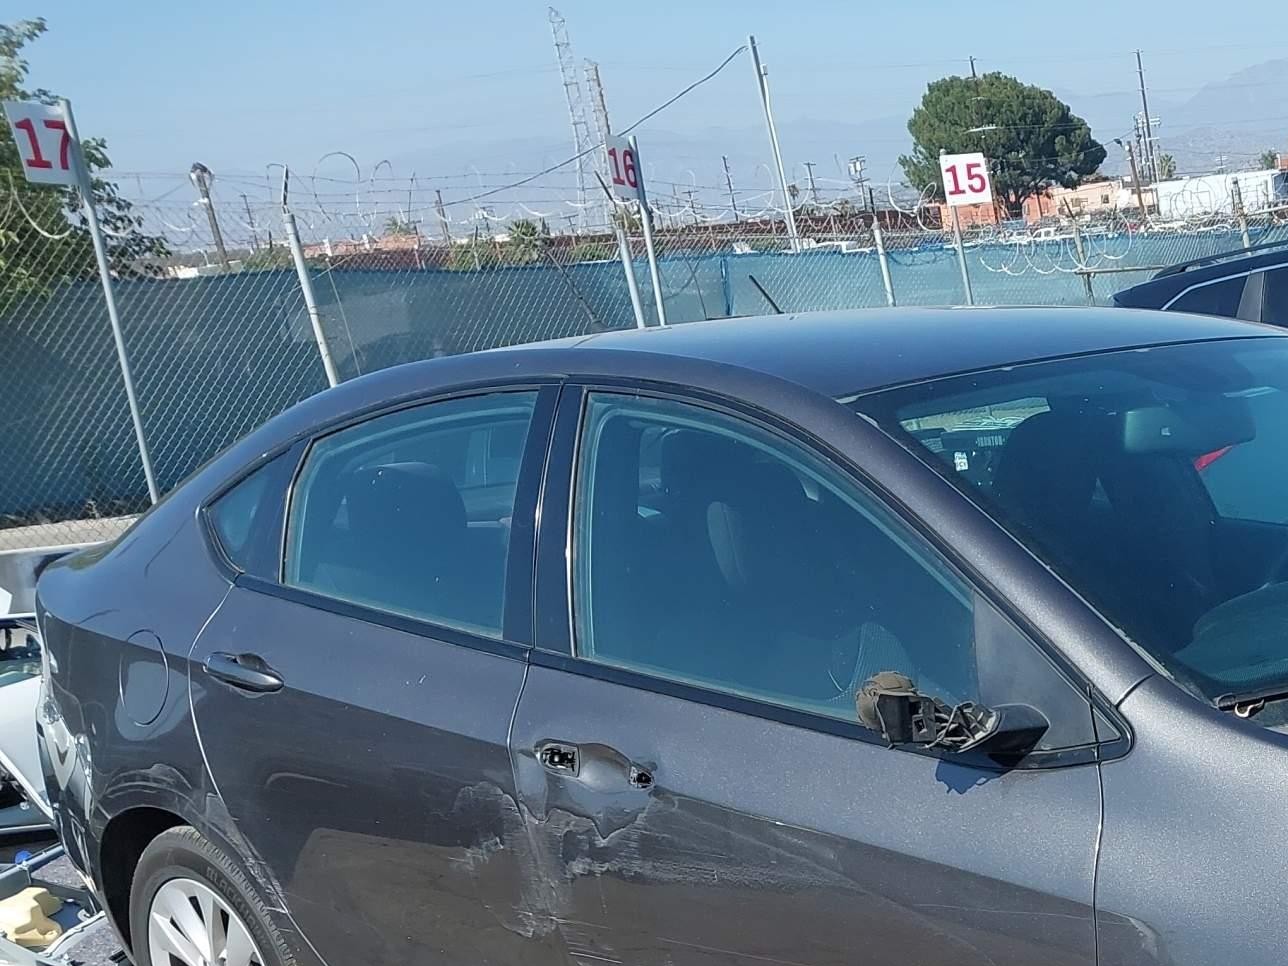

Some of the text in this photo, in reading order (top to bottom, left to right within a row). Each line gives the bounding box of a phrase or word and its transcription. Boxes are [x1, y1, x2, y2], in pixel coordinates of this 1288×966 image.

[14, 117, 71, 171] 17
[608, 147, 638, 188] 16
[944, 162, 987, 196] 15
